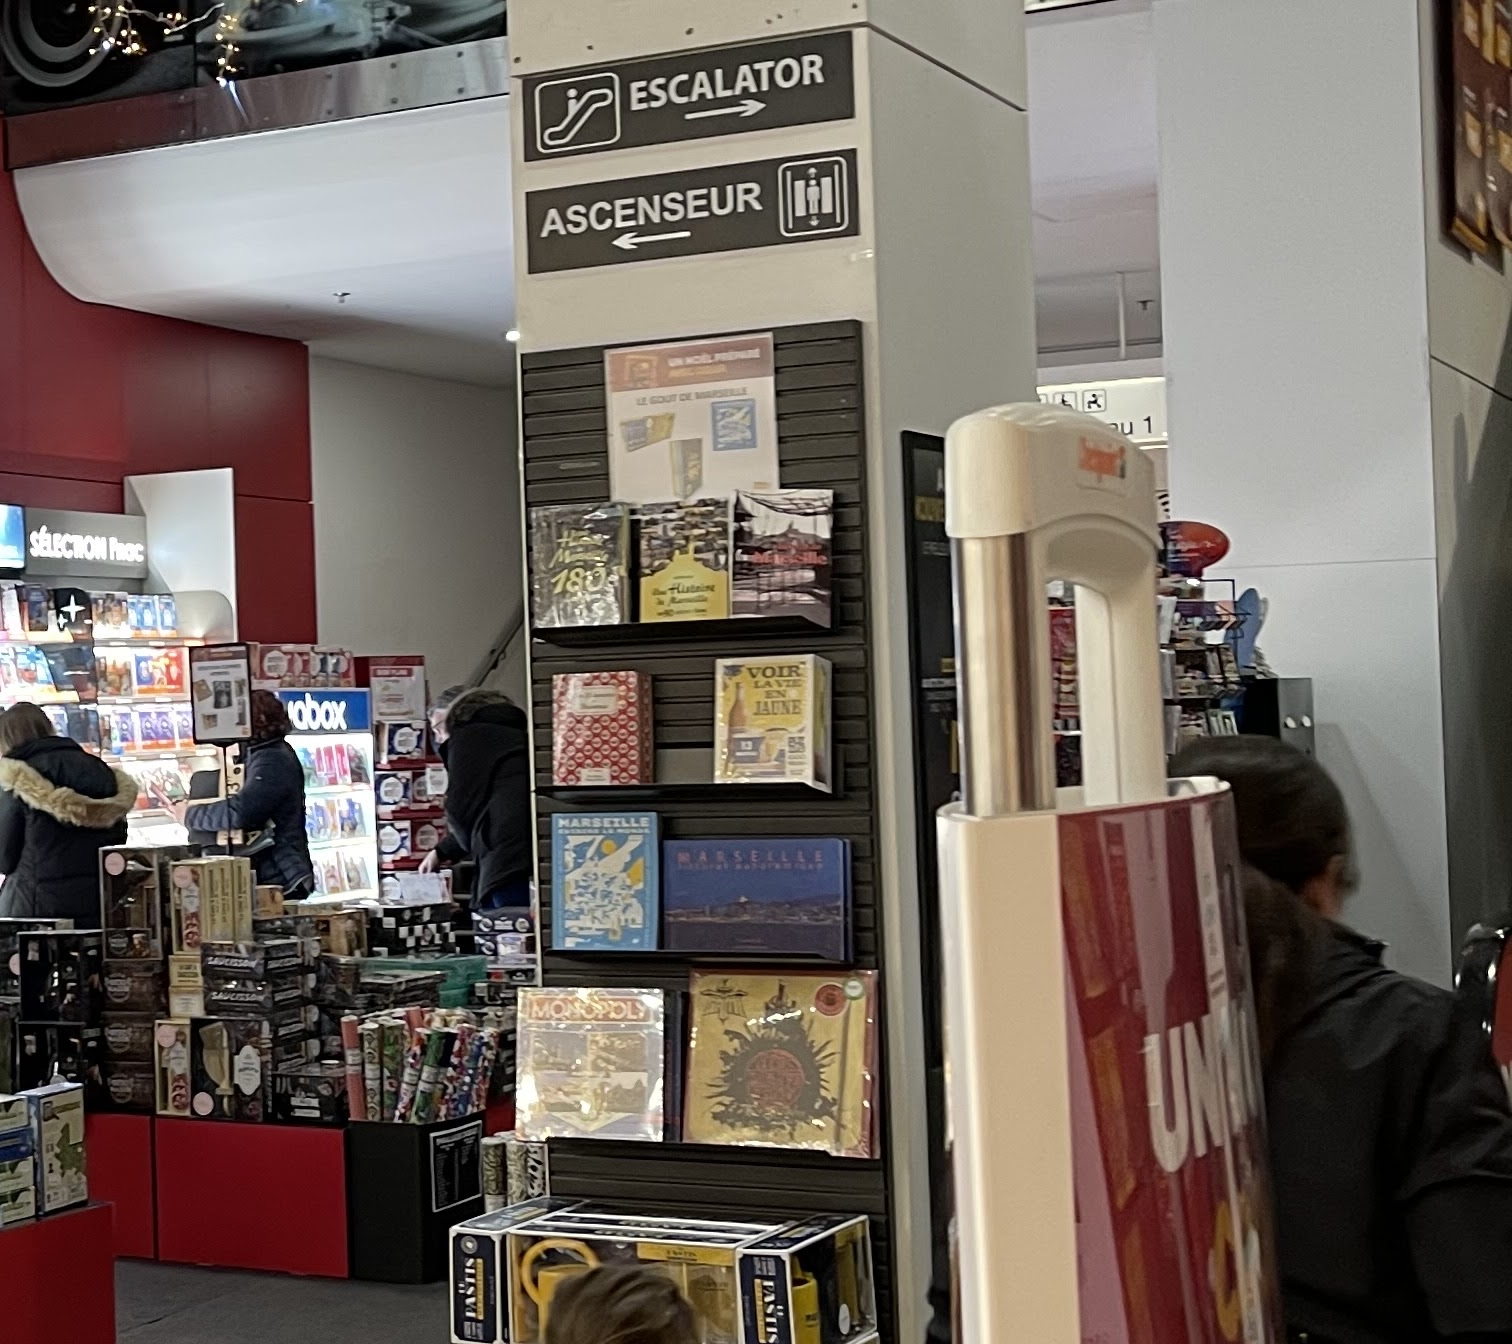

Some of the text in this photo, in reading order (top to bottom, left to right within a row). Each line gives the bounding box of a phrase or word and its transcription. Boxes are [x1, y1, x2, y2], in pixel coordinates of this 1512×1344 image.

[629, 53, 825, 112] ESCALATOR
[540, 181, 764, 239] ASCENSEUR
[1143, 416, 1152, 434] 1
[29, 524, 107, 561] SÉLECTION
[747, 665, 802, 678] VOIR
[764, 689, 787, 699] EN
[558, 817, 649, 828] MARSEILLE
[531, 999, 646, 1022] MONOPOLY
[1144, 1013, 1230, 1173] UN
[464, 1257, 476, 1318] PASTIS
[762, 1280, 779, 1344] PASTIS
